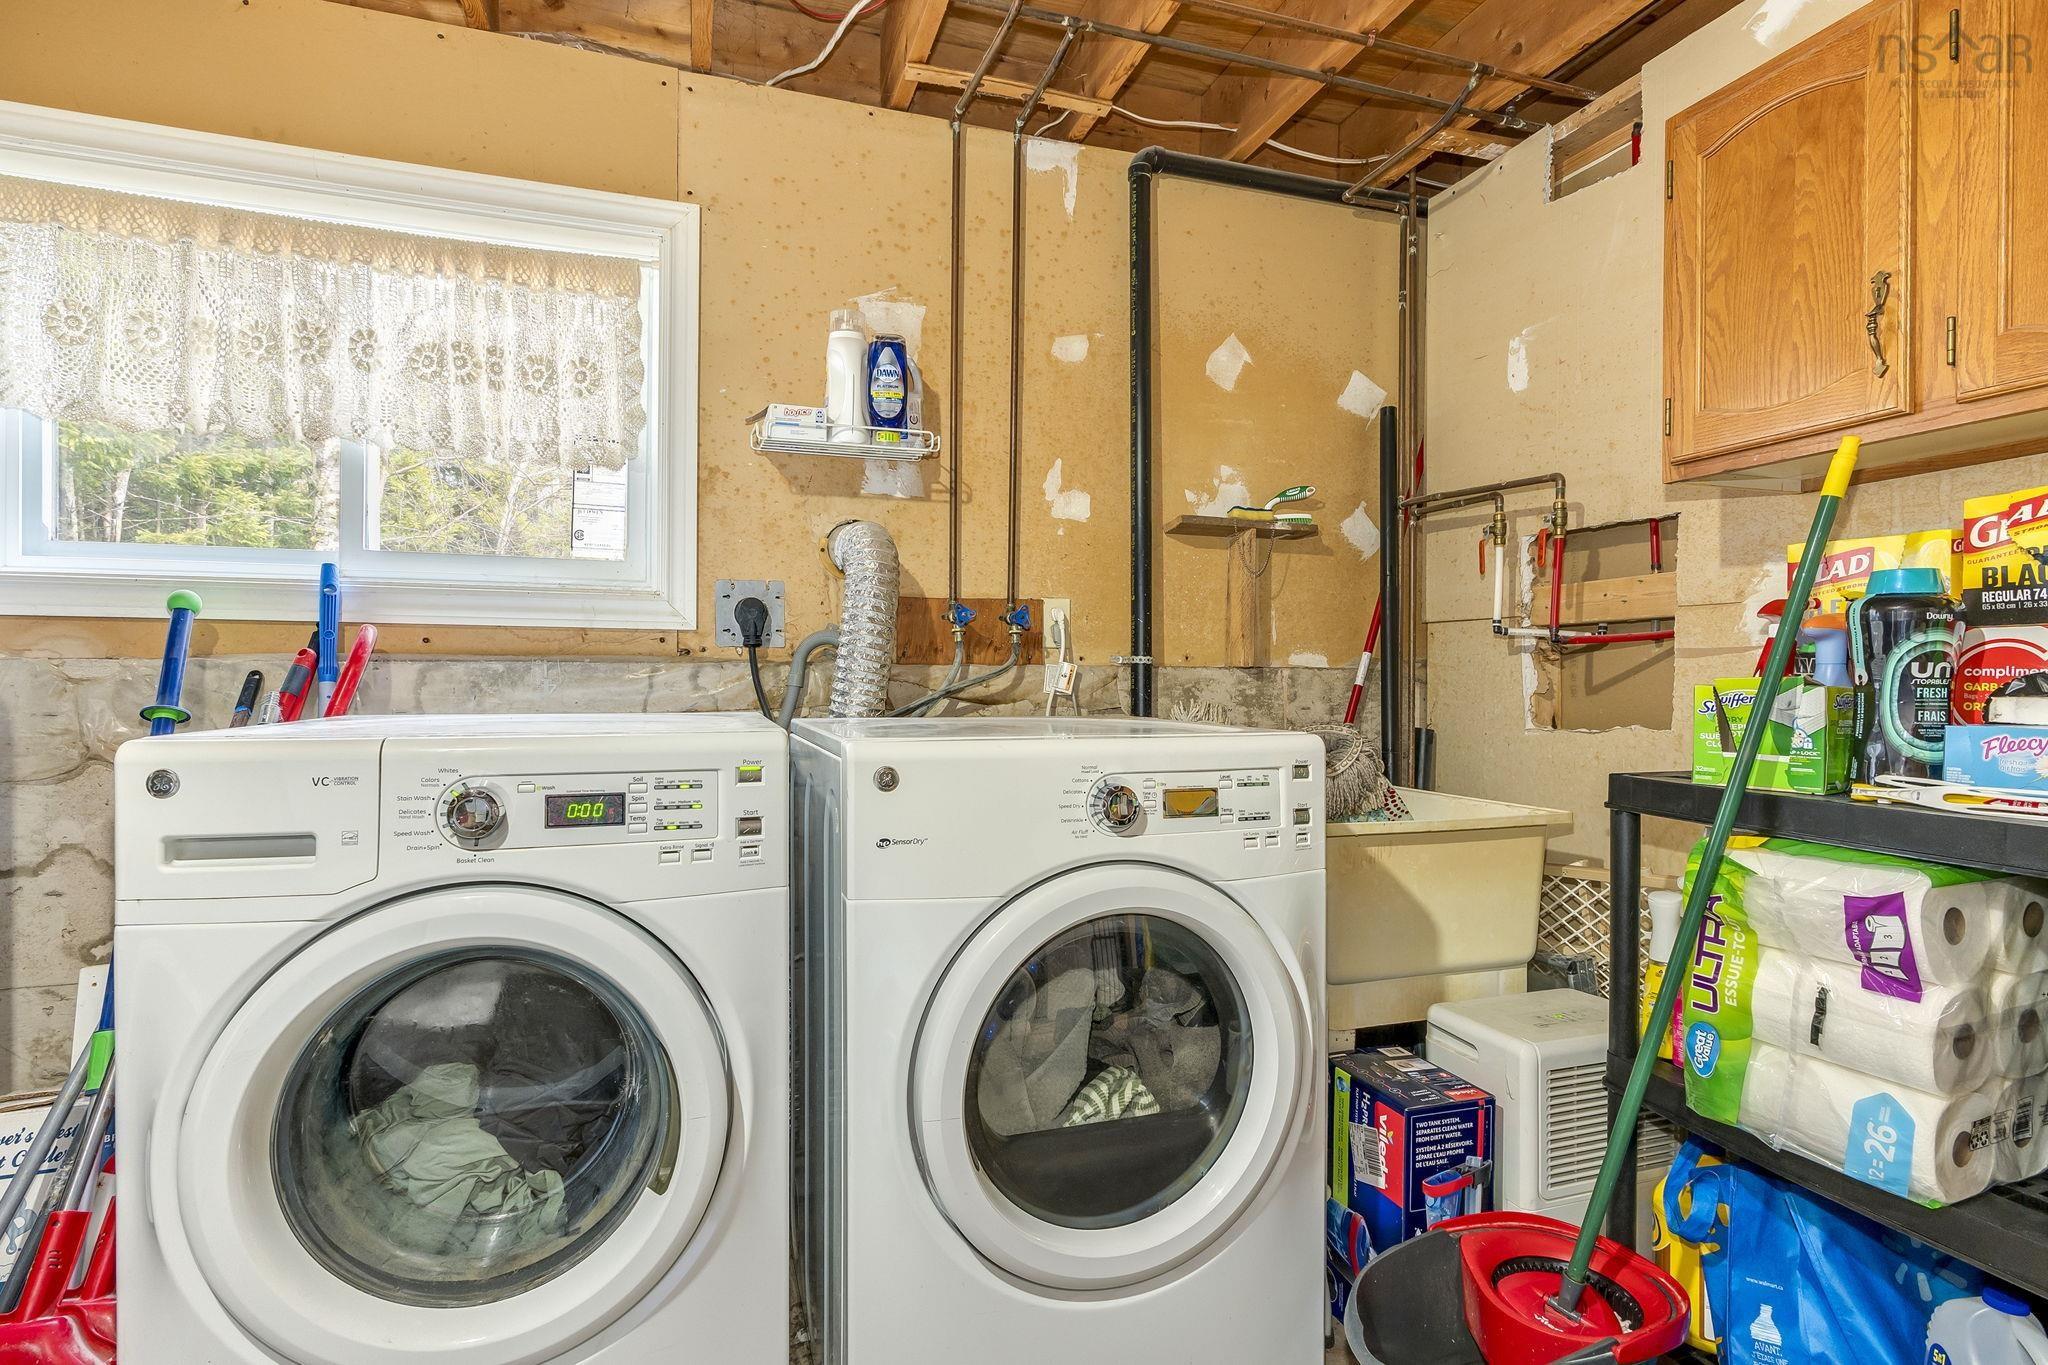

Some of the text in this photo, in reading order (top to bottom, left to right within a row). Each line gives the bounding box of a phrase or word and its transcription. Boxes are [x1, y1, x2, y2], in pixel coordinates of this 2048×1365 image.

[876, 369, 899, 378] DAWN
[1982, 589, 2031, 603] REGULAR
[1926, 612, 1953, 621] Downy
[1917, 687, 1948, 699] FRESH
[1918, 710, 1946, 722] FRAIS
[312, 777, 330, 786] VC
[1693, 1029, 1707, 1069] Great
[1702, 1030, 1715, 1062] Value
[1415, 1127, 1442, 1136] SEPARATES
[1457, 1122, 1474, 1130] WATER
[1428, 1119, 1441, 1127] TANK
[1445, 1140, 1474, 1149] RÉSERVOIRS.
[1863, 1120, 1898, 1162] 26
[1415, 1148, 1465, 1161] SÉPARE L'EAU PROPRE
